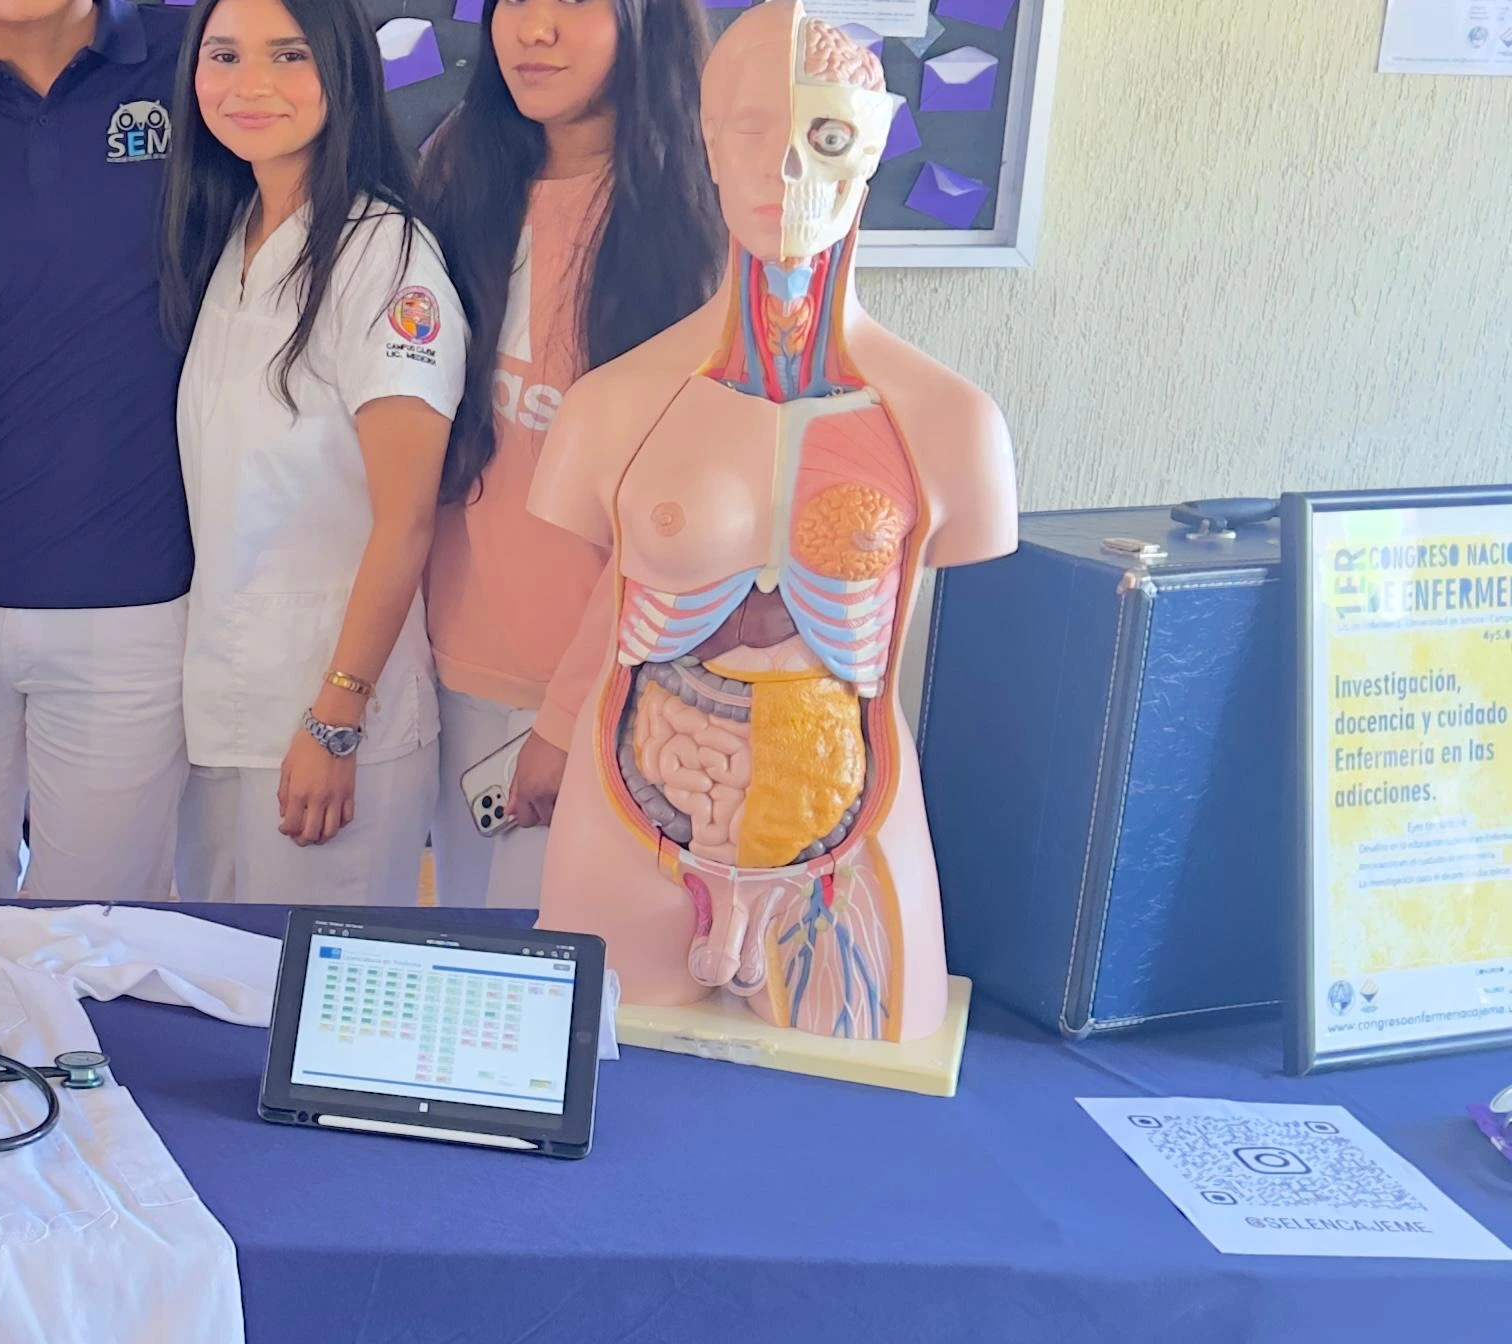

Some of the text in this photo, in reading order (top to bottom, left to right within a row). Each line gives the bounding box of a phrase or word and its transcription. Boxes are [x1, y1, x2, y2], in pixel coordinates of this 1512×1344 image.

[108, 129, 172, 157] SEM
[1368, 543, 1460, 571] CONGRESO
[1335, 668, 1461, 700] Investigación,
[1335, 701, 1508, 735] docencia y cuidado
[1335, 738, 1495, 772] Enfermería en las
[1335, 781, 1436, 808] adicciones.
